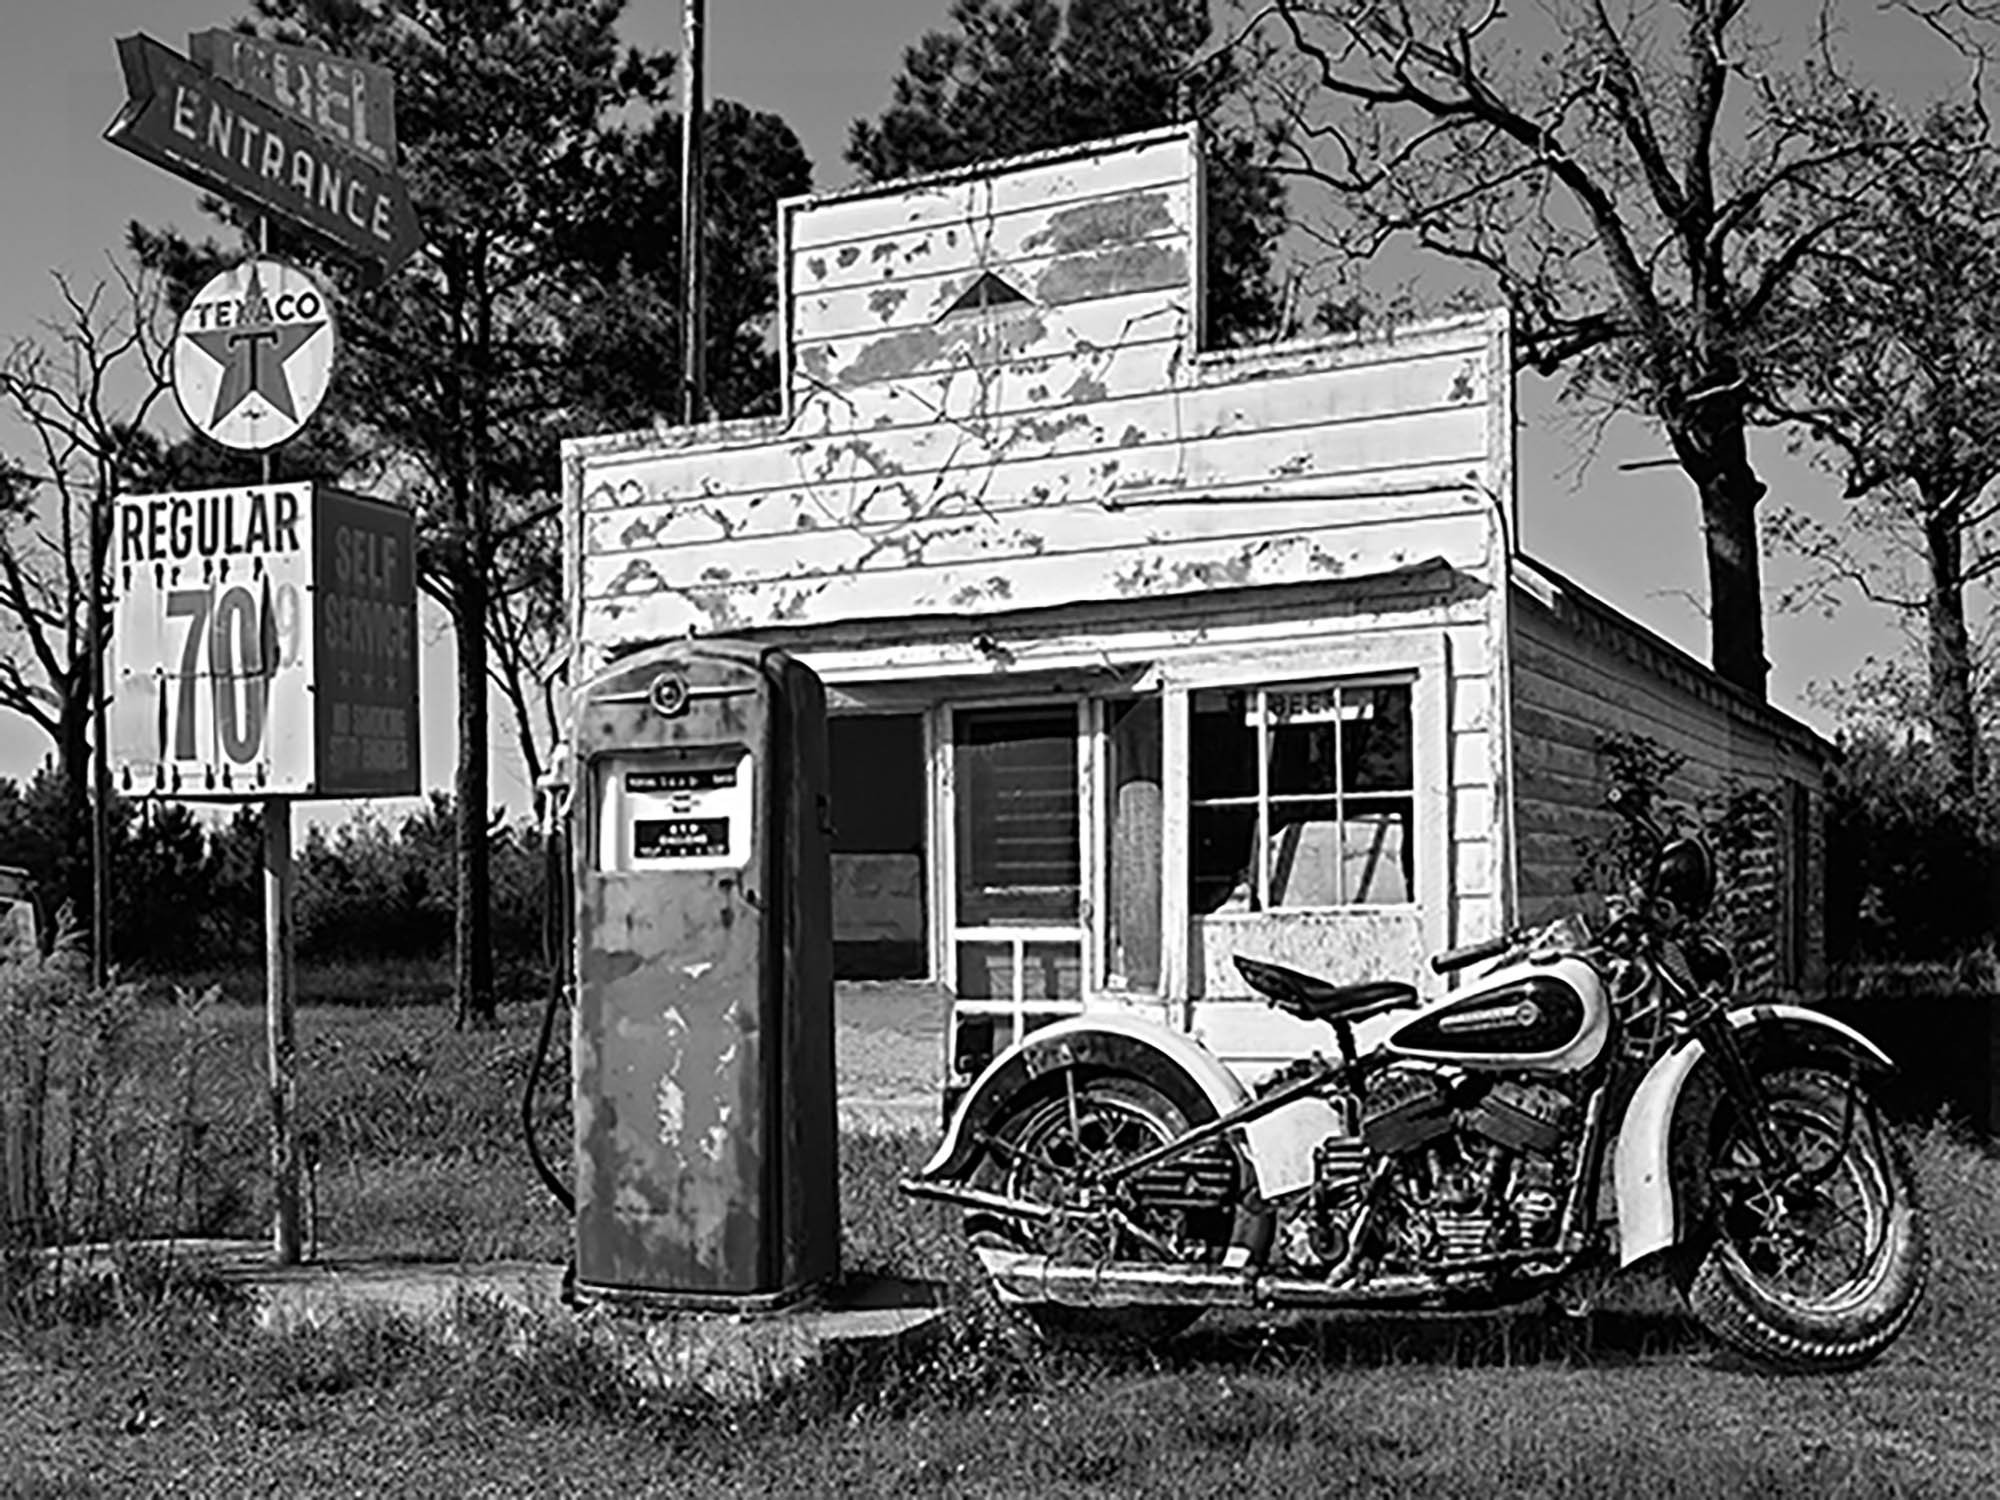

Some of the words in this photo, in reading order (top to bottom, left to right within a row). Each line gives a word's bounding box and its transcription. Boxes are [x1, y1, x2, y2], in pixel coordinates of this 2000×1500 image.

[174, 86, 391, 241] ENTRANCE
[194, 291, 320, 328] TEXACO
[121, 492, 300, 561] REGULAR
[335, 525, 397, 588] SELF
[325, 592, 409, 659] SERVICE
